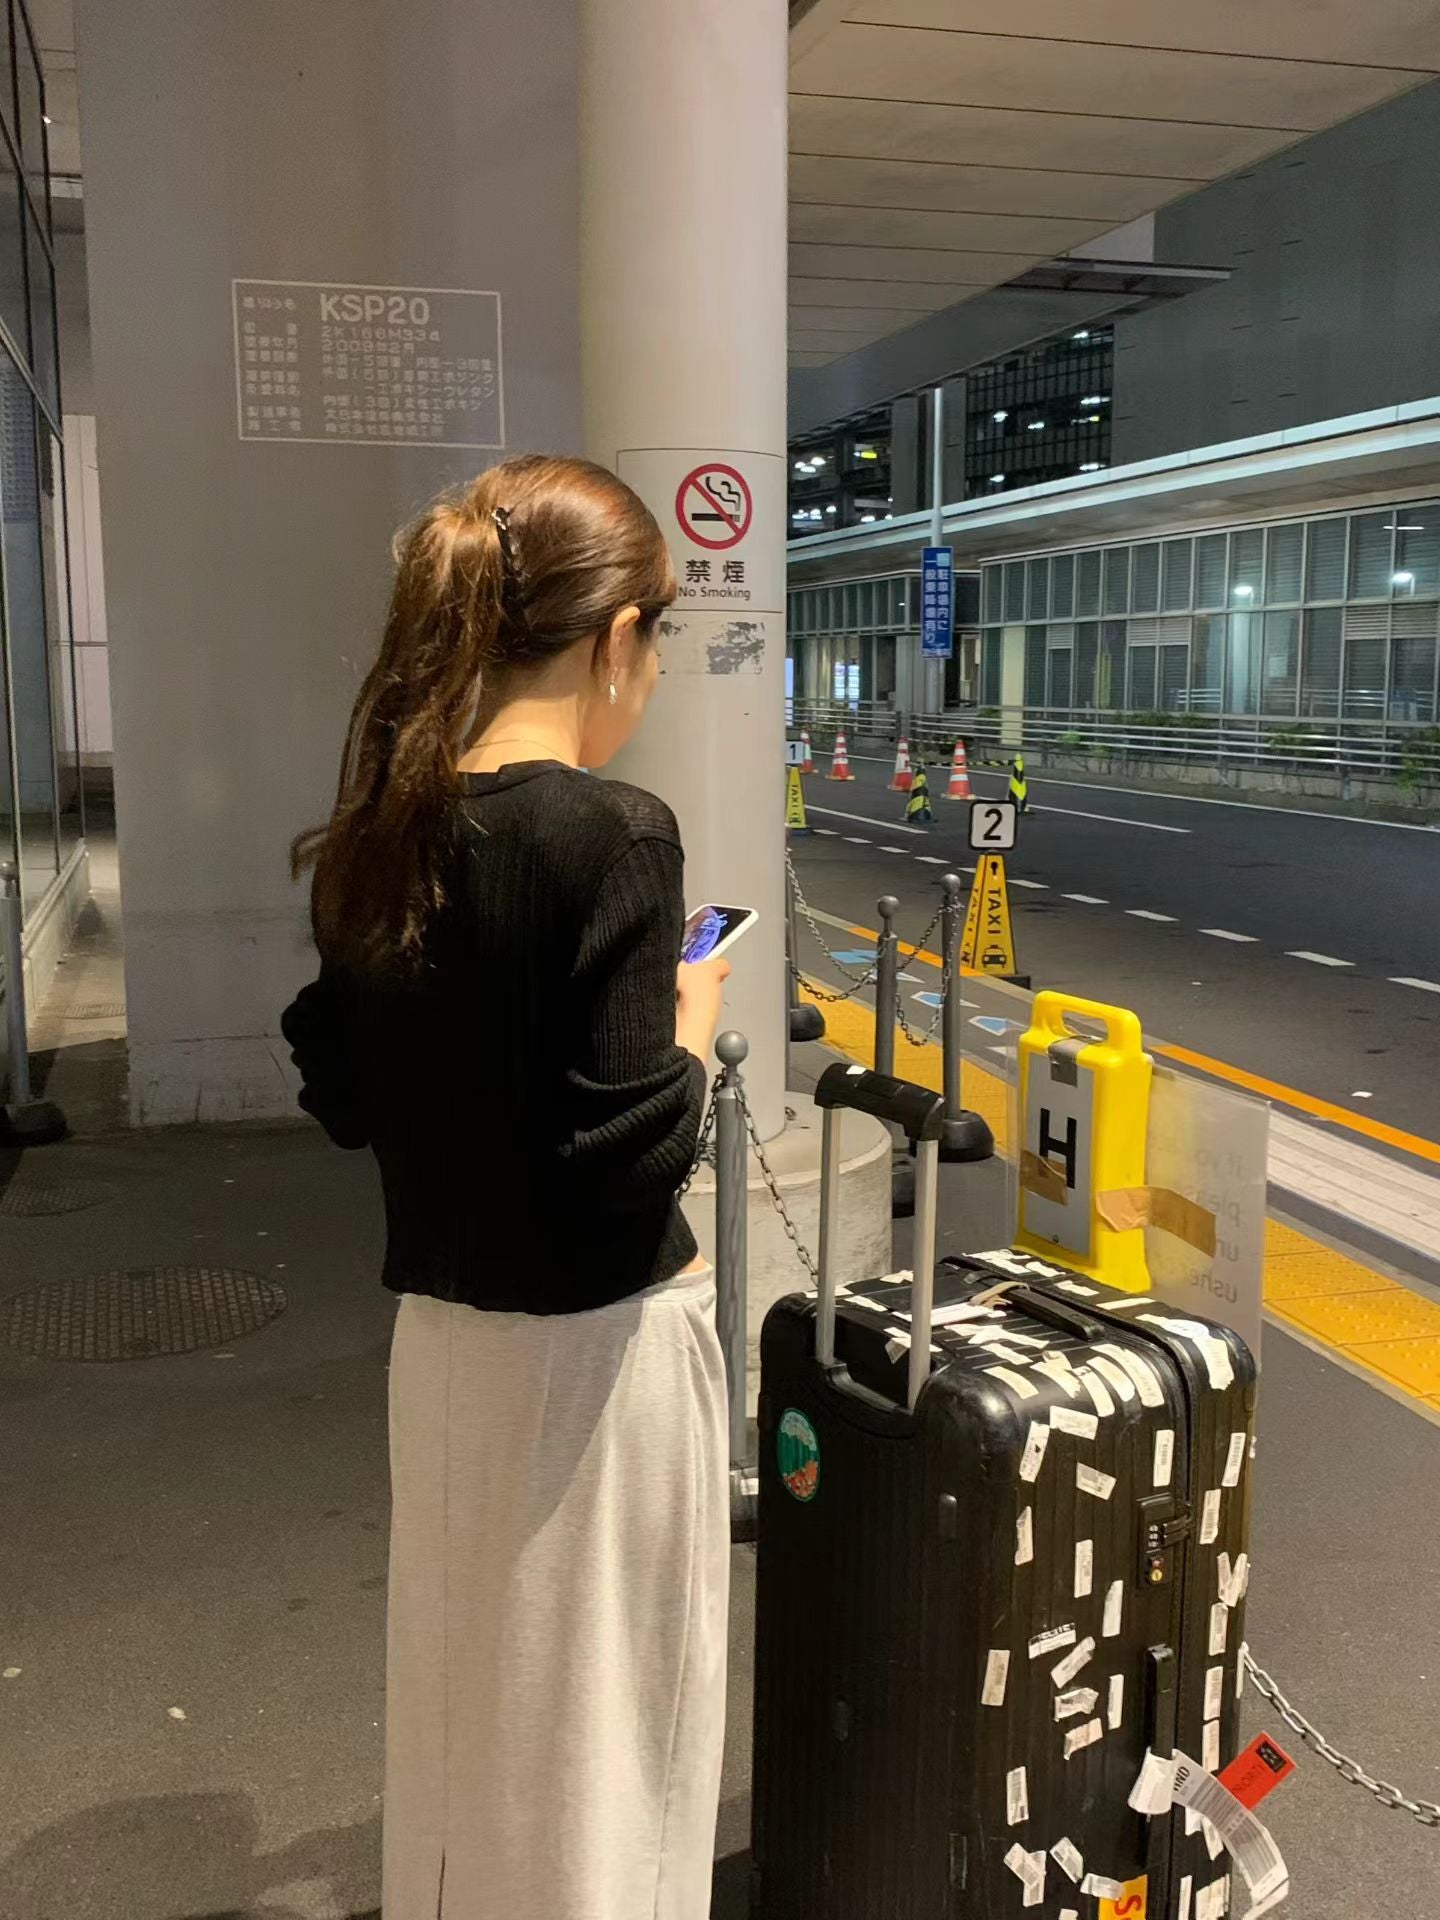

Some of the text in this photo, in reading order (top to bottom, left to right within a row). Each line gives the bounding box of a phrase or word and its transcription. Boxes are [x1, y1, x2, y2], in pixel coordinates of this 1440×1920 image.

[319, 293, 430, 325] KSP20
[686, 559, 745, 584] 禁煙
[678, 586, 750, 600] No Smoking
[789, 744, 796, 760] 1
[983, 808, 1003, 841] 2
[988, 888, 1001, 934] TAXI
